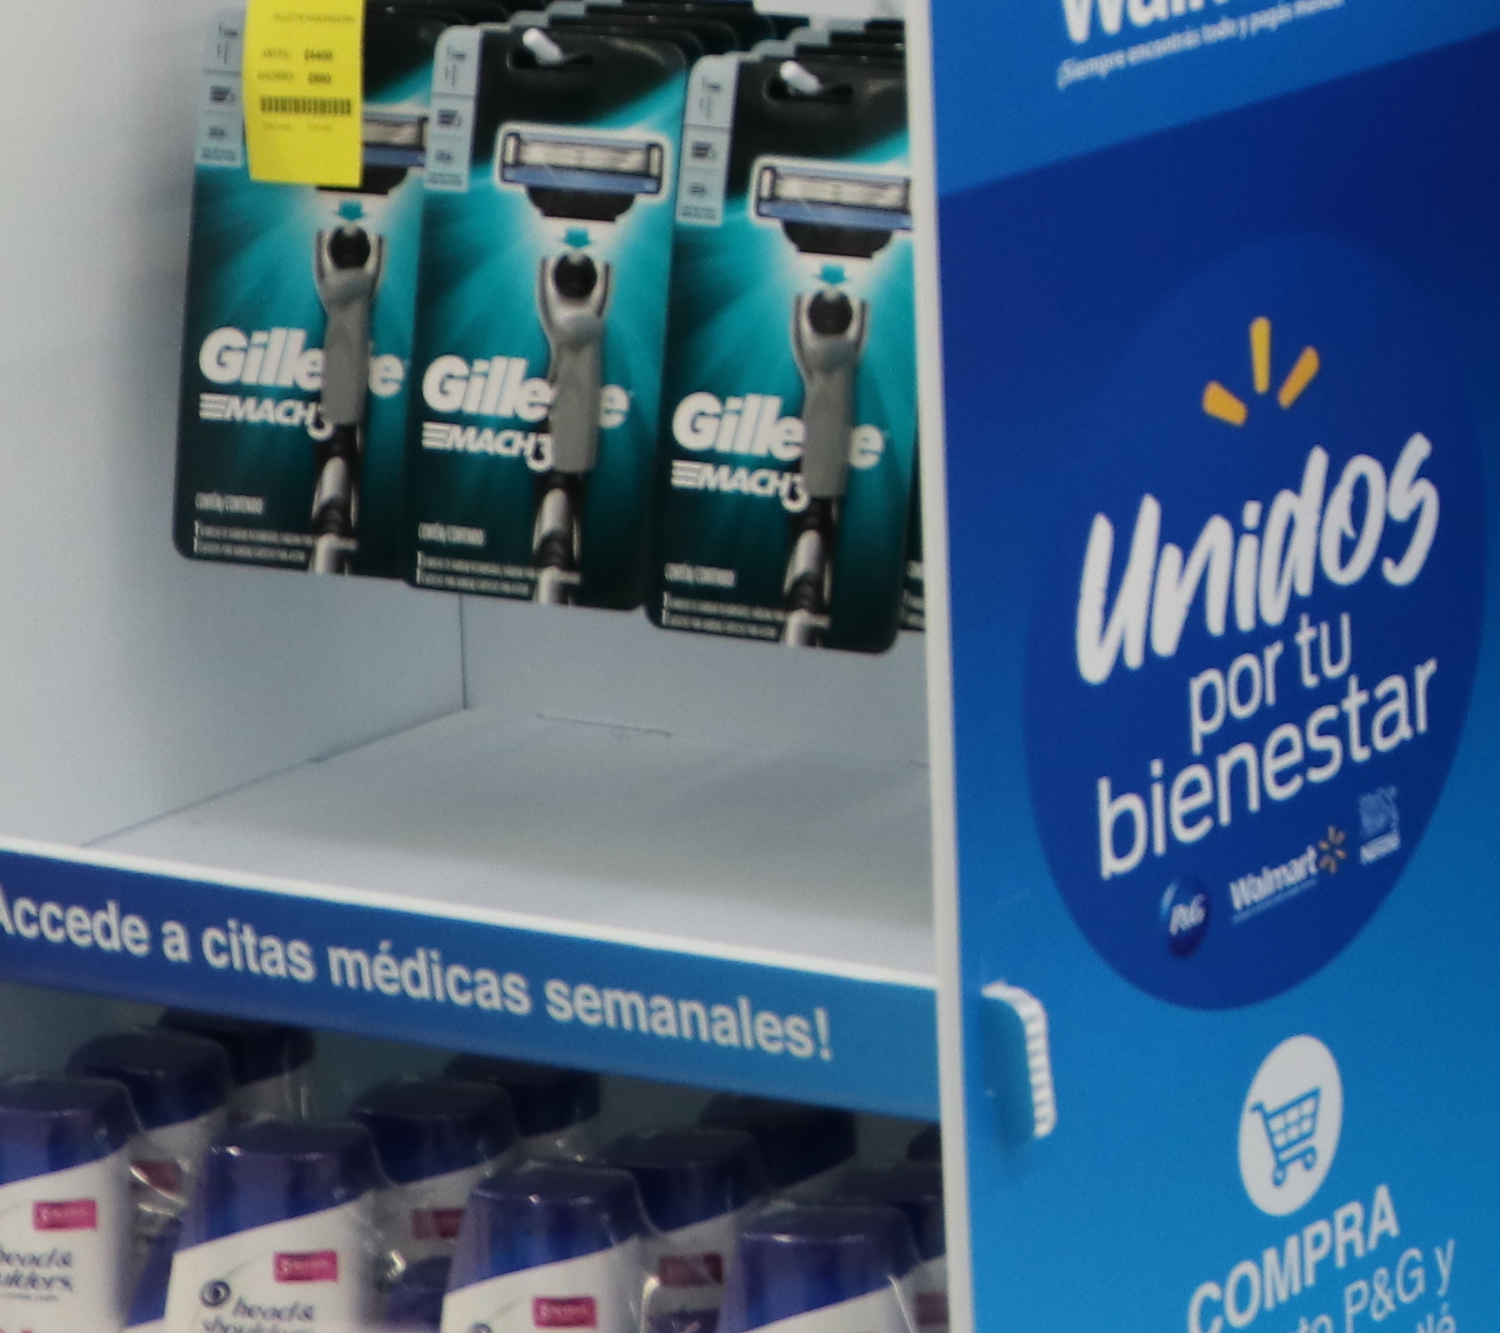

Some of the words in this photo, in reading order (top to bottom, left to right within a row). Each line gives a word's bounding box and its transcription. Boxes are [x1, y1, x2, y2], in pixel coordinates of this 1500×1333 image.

[422, 353, 632, 429] Gillee
[163, 919, 189, 963] a
[202, 917, 316, 983] citas
[329, 939, 530, 1018] médicas
[544, 980, 833, 1063] semanales!
